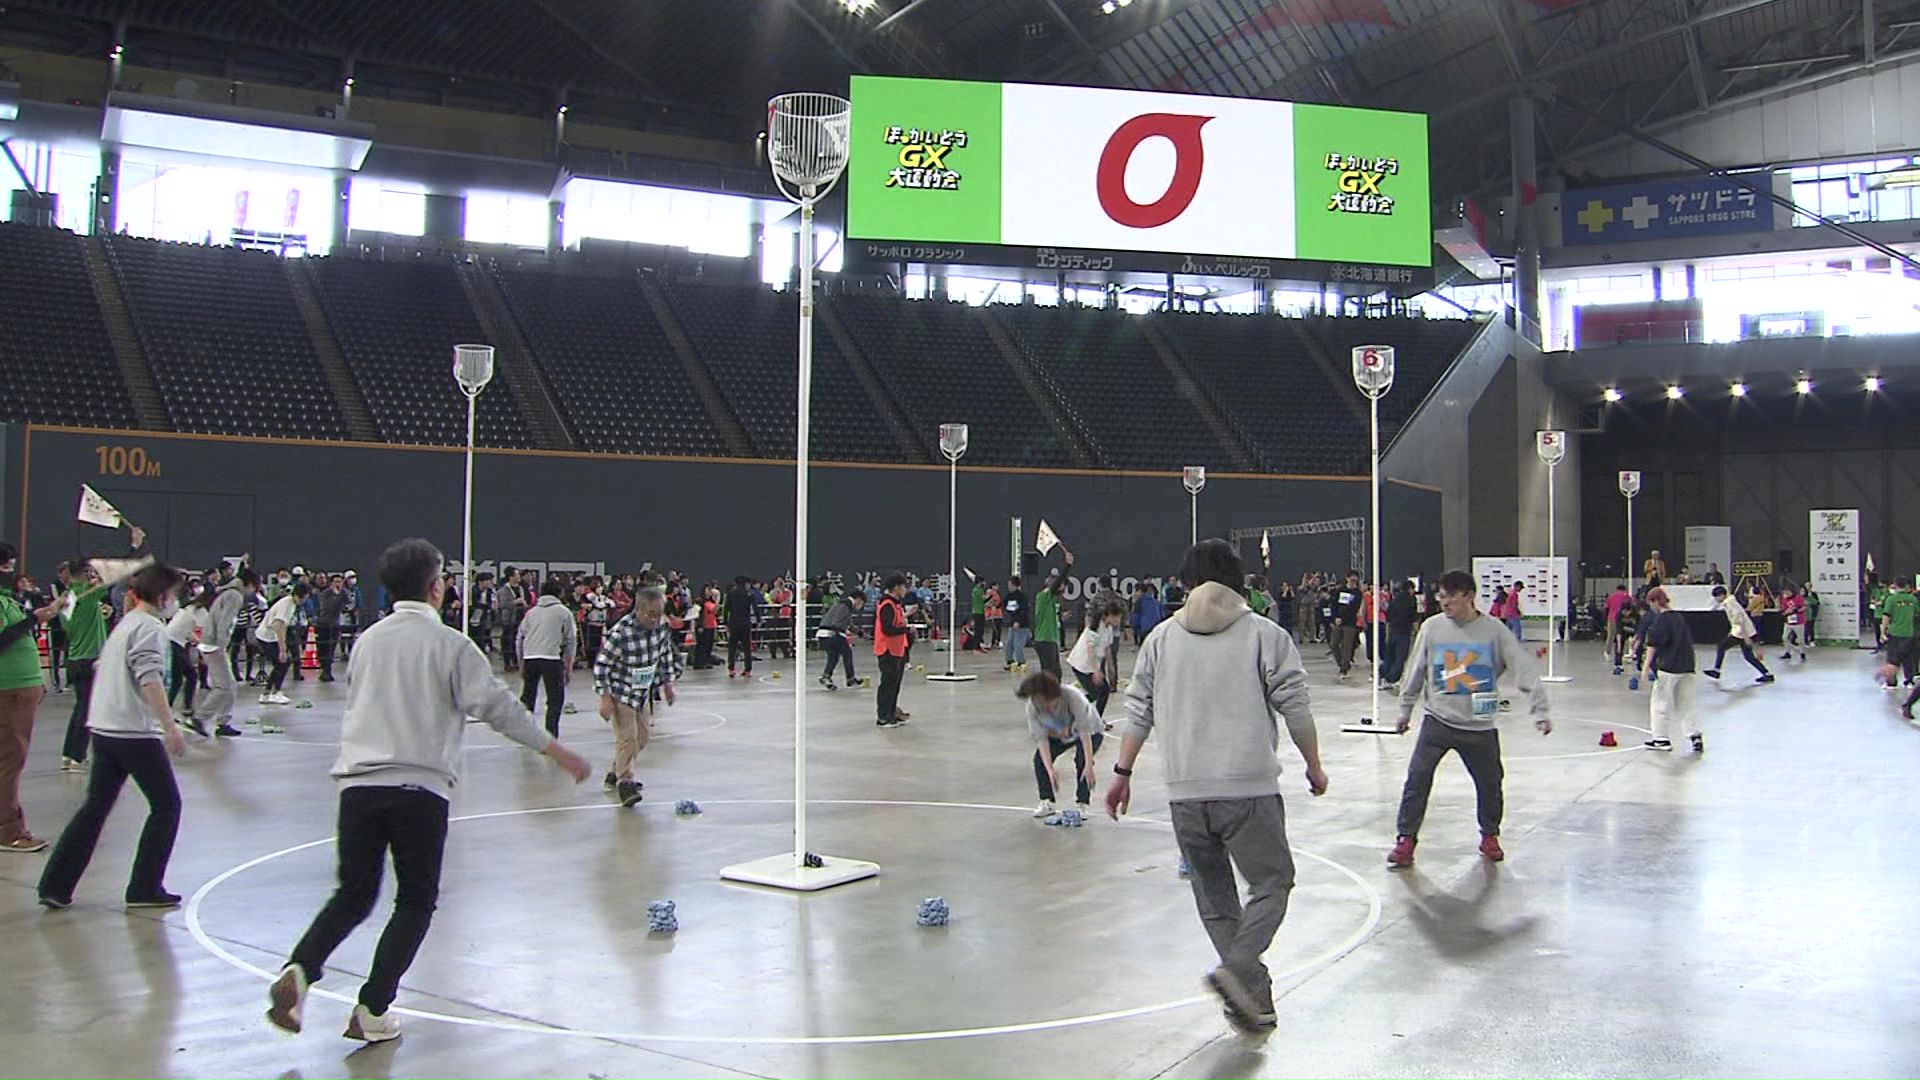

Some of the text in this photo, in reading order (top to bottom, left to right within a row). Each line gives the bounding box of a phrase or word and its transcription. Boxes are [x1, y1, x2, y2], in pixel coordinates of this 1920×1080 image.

[884, 126, 968, 147] ほっかいどう
[899, 144, 950, 170] GX
[1324, 153, 1399, 175] ほっかいどう
[885, 167, 961, 190] 大運動会
[1339, 170, 1385, 196] GX
[1327, 193, 1394, 215] 大運動会
[1667, 187, 1756, 212] サツドラ
[1668, 209, 1756, 225] SAPPORO DRUG STORE
[1543, 432, 1553, 445] 5
[1443, 650, 1480, 692] K
